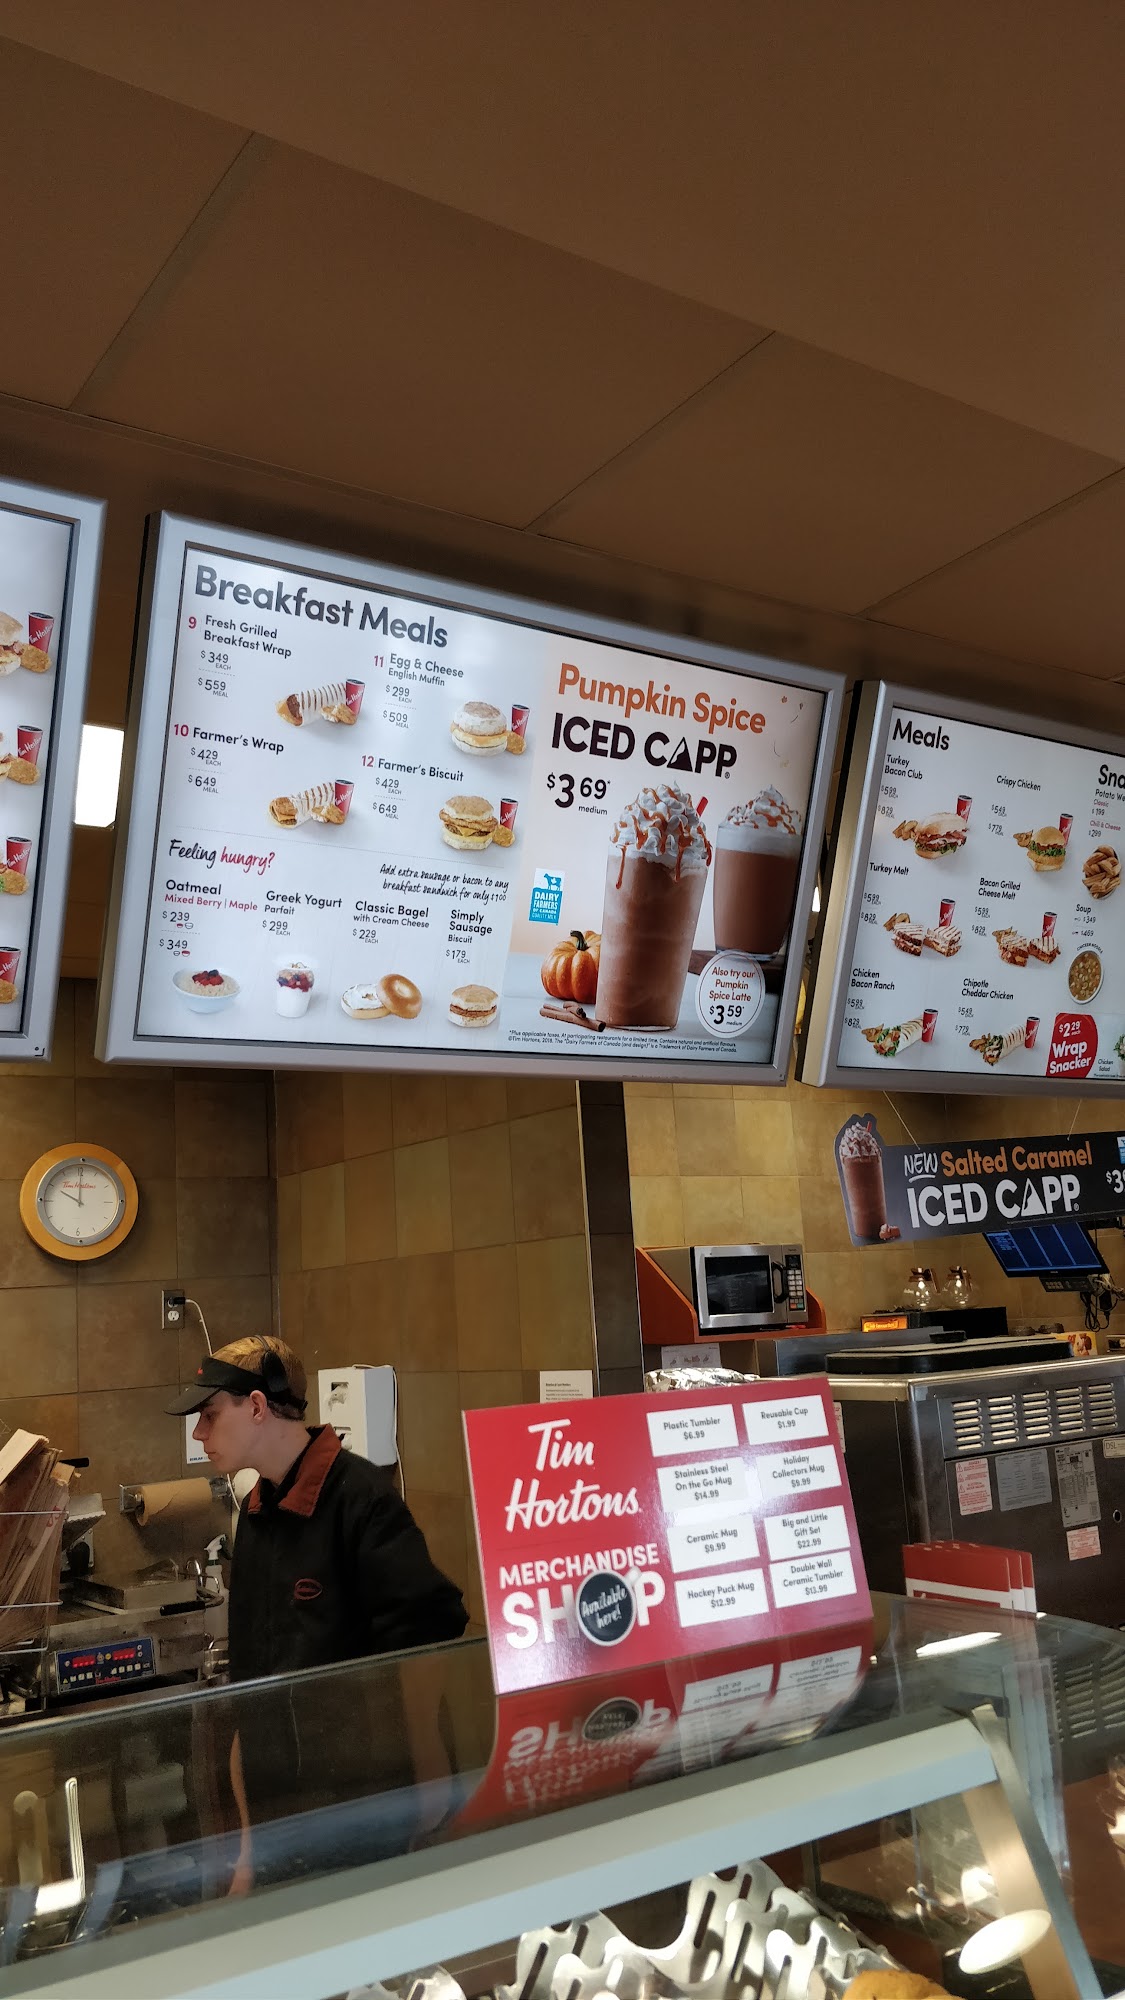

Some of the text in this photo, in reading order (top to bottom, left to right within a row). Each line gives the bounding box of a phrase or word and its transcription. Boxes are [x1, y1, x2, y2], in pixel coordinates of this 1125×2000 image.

[195, 565, 448, 648] Breakfast Meals
[188, 615, 277, 639] 9 Fresh Grilled
[204, 630, 292, 659] Breakfast Wrap
[374, 653, 464, 677] 11 Egg & Cheese
[389, 668, 445, 686] English Muffin
[213, 690, 228, 698] MEAL
[559, 663, 766, 735] Pumpkin Spice
[174, 724, 284, 755] 10 Farmer's Wrap
[552, 712, 636, 760] ICED
[892, 718, 950, 751] Meals
[887, 754, 910, 768] Turkey
[362, 755, 464, 782] 12 Farmer's Biscuit
[885, 766, 923, 780] Bacon Club
[203, 786, 219, 794] MEAL
[997, 775, 1041, 791] Crispy Chicken
[1095, 789, 1115, 799] Potato
[579, 805, 608, 815] medium
[169, 839, 275, 875] Feeling hungry?
[870, 863, 909, 876] Turkey Melt
[380, 864, 509, 893] Add extra sausage or bacon to any
[980, 878, 1021, 891] Bacon Grilled
[166, 880, 222, 895] Oatmeal
[383, 879, 488, 905] breakfast sandwich for only
[978, 888, 1016, 900] Cheese Melt
[165, 894, 258, 912] Mixed Berry Maple
[267, 891, 342, 909] Greek Yogurt
[535, 892, 559, 901] DAIRY
[265, 905, 295, 915] Parfait
[356, 901, 429, 919] Classic Bagel
[534, 900, 558, 910] FARMERS
[1076, 904, 1091, 915] Soup
[353, 914, 430, 928] with Cream Cheese
[451, 910, 484, 924] Simply
[449, 922, 493, 936] Sausage
[448, 935, 472, 943] Biscuit
[712, 967, 728, 976] Also
[730, 969, 741, 979] try
[852, 968, 880, 979] Chicken
[716, 979, 749, 990] Pumpkin
[851, 979, 895, 990] Bacon Ranch
[963, 978, 989, 989] Chipotle
[709, 991, 752, 1002] Spice Latte
[962, 989, 1014, 1000] Cheddar Chicken
[1052, 1041, 1088, 1058] Wrap
[1050, 1056, 1092, 1074] Snacker
[904, 1140, 1093, 1177] NEW Salted Caramel
[78, 1167, 84, 1177] 12
[907, 1183, 988, 1229] ICED
[76, 1227, 80, 1236] 6
[761, 1407, 809, 1420] Reusable Cup
[663, 1417, 721, 1431] Plastic Tumbler
[778, 1420, 796, 1429] $1.99
[684, 1430, 705, 1440] $6.99
[528, 1418, 594, 1472] Tim
[783, 1455, 810, 1465] Holiday
[675, 1464, 729, 1479] Stainless Steel
[772, 1464, 826, 1479] Collectors Mug
[676, 1475, 733, 1491] On the Go Mug
[791, 1477, 811, 1488] $9.99
[694, 1490, 719, 1501] $14.99
[504, 1478, 639, 1533] Hortons
[782, 1513, 828, 1529] Big and Little
[687, 1528, 739, 1544] Ceramic Mug
[794, 1526, 821, 1538] Gift Set
[705, 1542, 727, 1553] $9.99
[797, 1538, 822, 1549] $22.99
[499, 1543, 660, 1590] MERCHANDISE
[791, 1559, 833, 1574] Double Wall
[783, 1570, 844, 1587] Ceramic Tumbler
[687, 1582, 755, 1601] Hockey Puck Mug
[805, 1584, 828, 1596] $13.99
[581, 1584, 627, 1618] Available
[711, 1597, 736, 1608] $12.99
[502, 1571, 666, 1650] SHOP
[596, 1607, 623, 1629] here!
